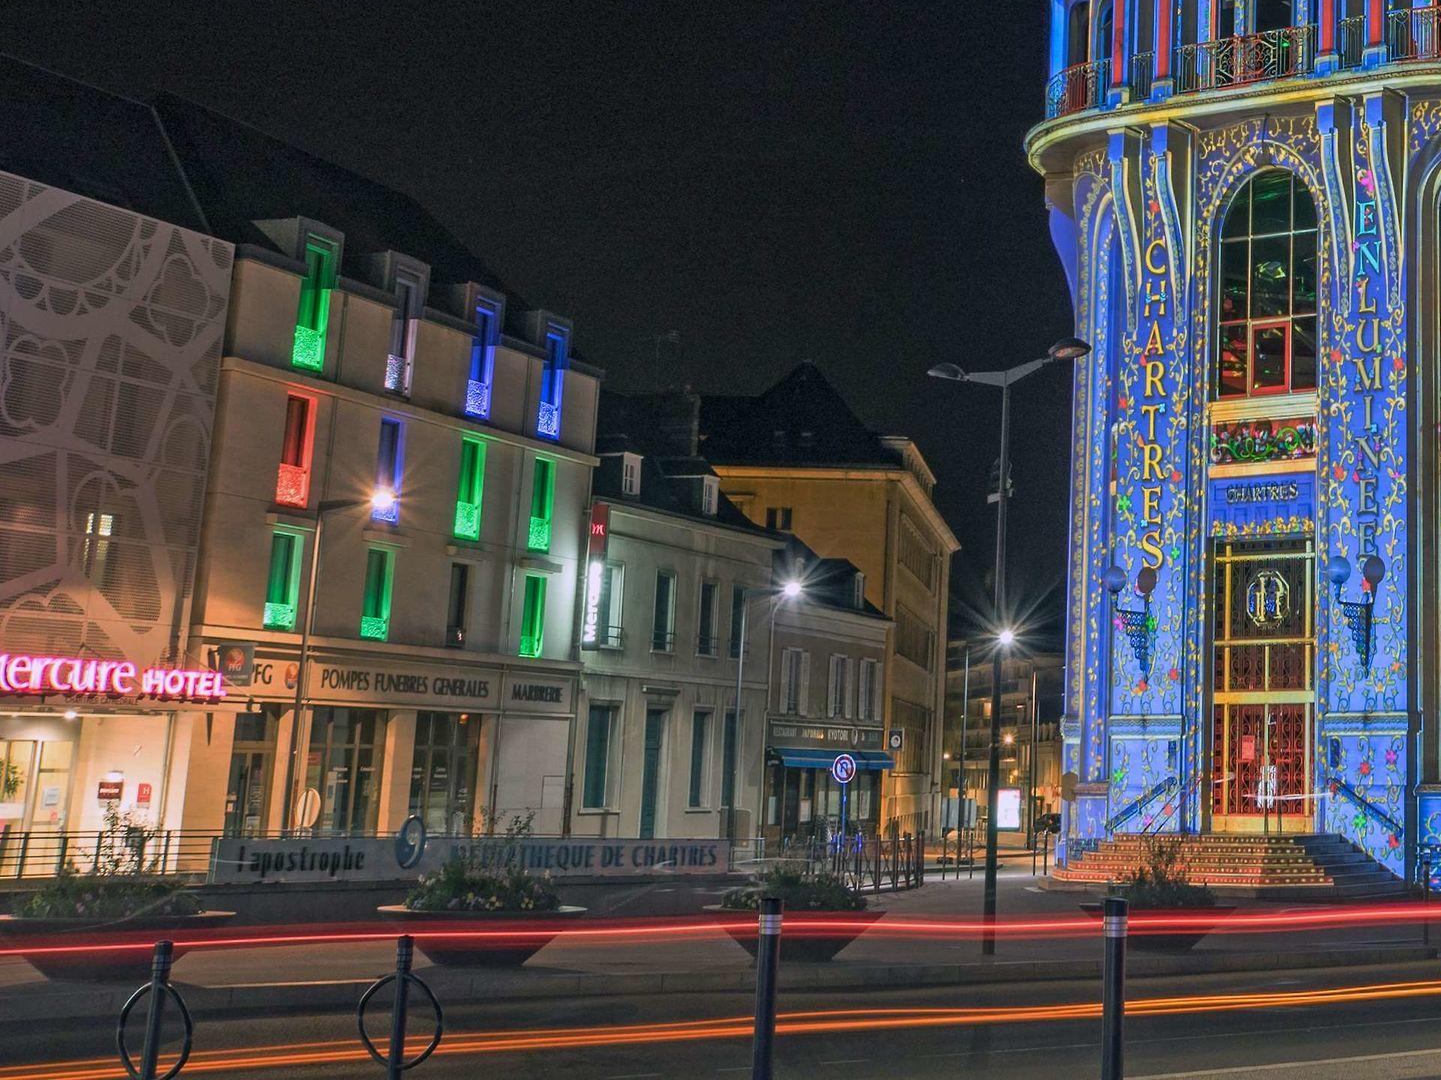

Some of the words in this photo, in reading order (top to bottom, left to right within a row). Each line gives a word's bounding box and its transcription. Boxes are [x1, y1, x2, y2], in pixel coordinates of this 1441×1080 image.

[1142, 239, 1168, 570] CHARTRES
[1226, 481, 1299, 504] CHARTRES
[142, 668, 227, 697] HOTEL
[252, 663, 273, 685] FG
[320, 668, 370, 692] POMPES
[374, 672, 429, 696] FUNEBRES
[432, 677, 489, 699] GENERALES
[601, 845, 624, 868] DE
[632, 845, 717, 869] CHARTRES
